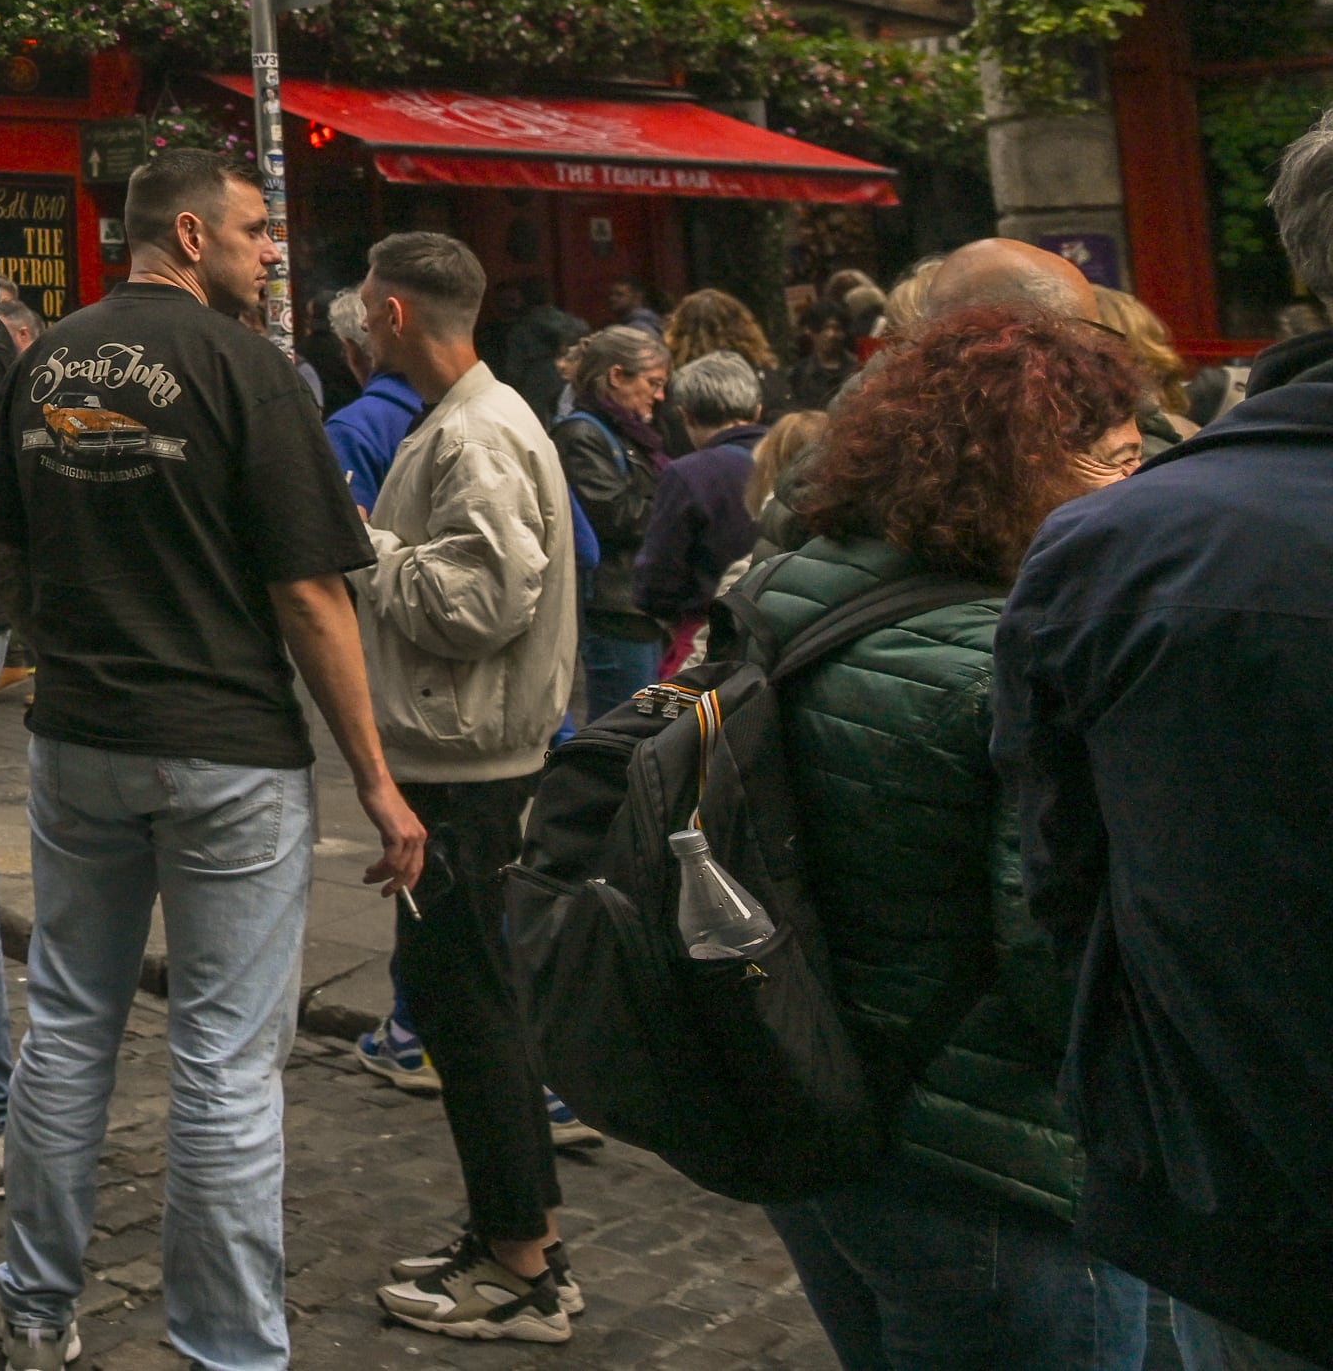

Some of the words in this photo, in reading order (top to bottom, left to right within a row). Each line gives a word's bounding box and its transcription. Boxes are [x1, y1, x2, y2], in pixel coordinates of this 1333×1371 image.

[554, 162, 594, 183] THE
[600, 165, 672, 187] TEMPLE
[674, 169, 711, 189] BAR
[33, 195, 66, 220] 1840
[23, 228, 64, 255] THE
[42, 289, 66, 318] OF
[30, 346, 111, 404] Sean
[97, 343, 182, 408] John
[40, 454, 56, 471] THE
[56, 464, 98, 481] ORIGINAL
